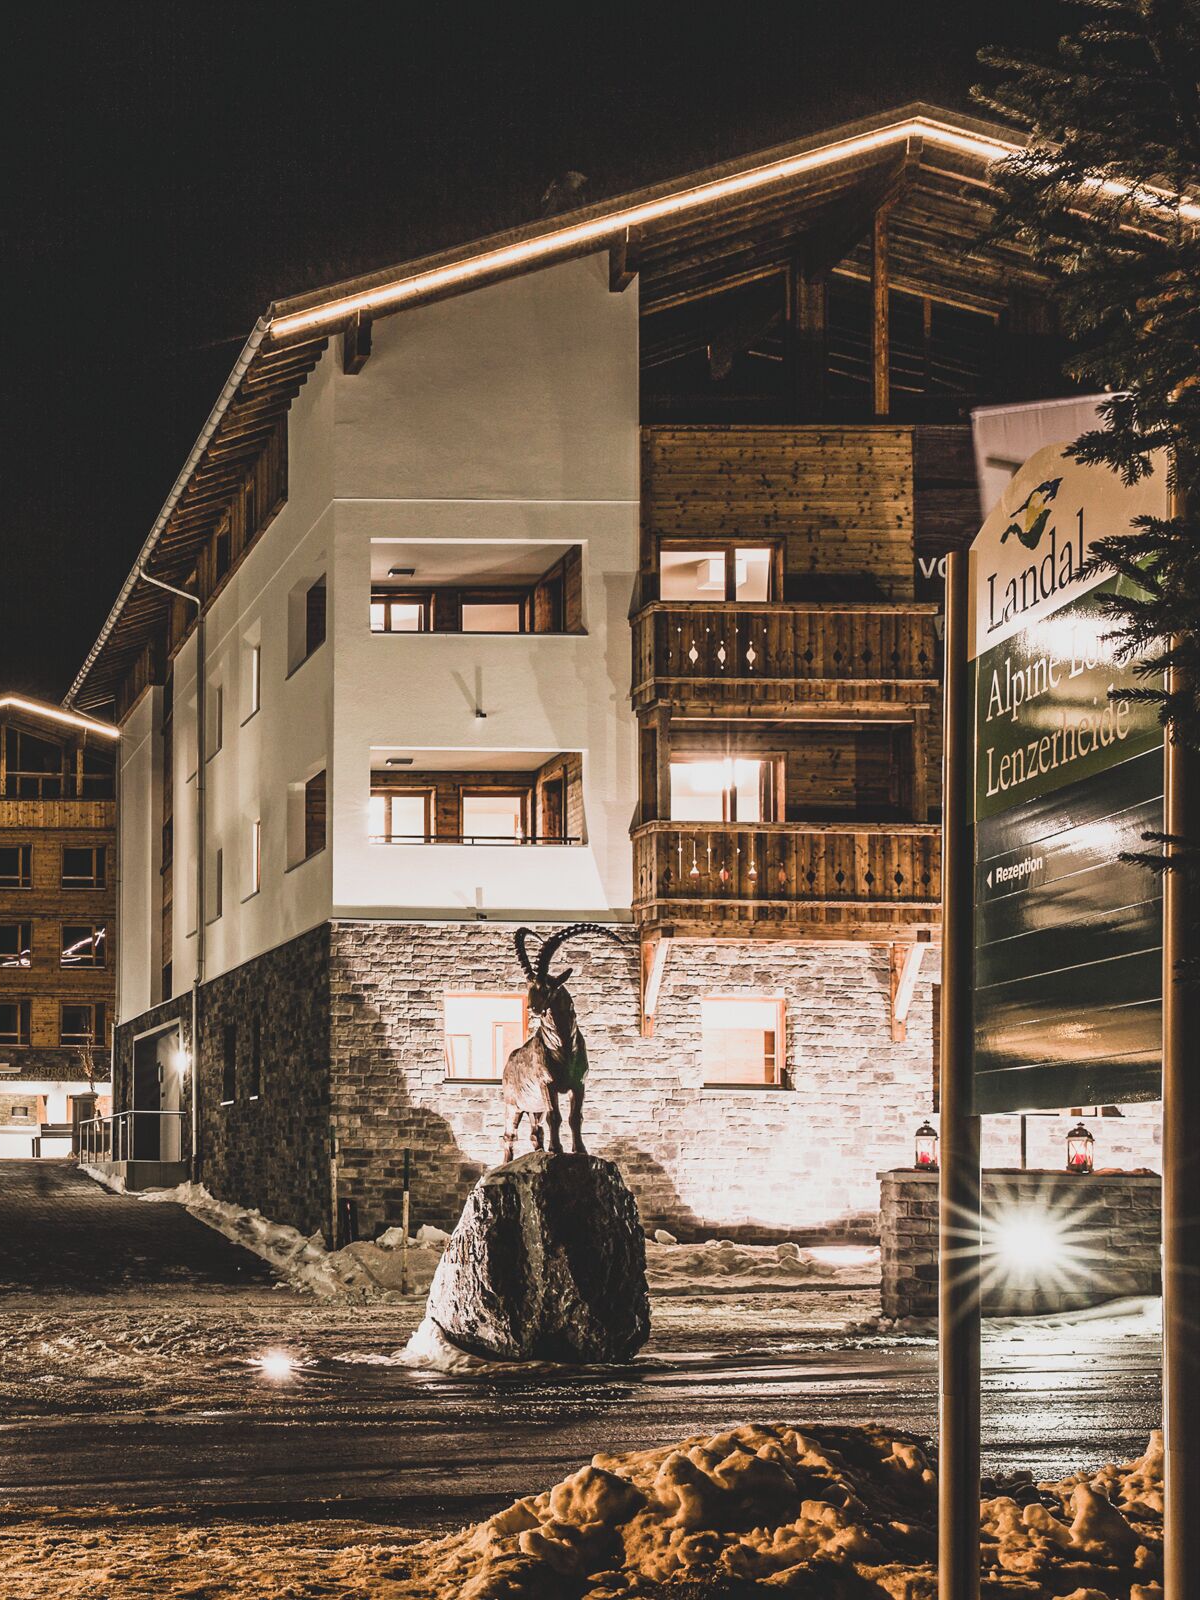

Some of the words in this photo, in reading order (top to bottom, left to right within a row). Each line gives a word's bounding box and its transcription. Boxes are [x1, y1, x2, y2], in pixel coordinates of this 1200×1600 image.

[987, 507, 1086, 634] Landal
[986, 655, 1063, 723] Alpine
[986, 683, 1131, 797] Lenzerheide
[996, 854, 1043, 884] Rezeption
